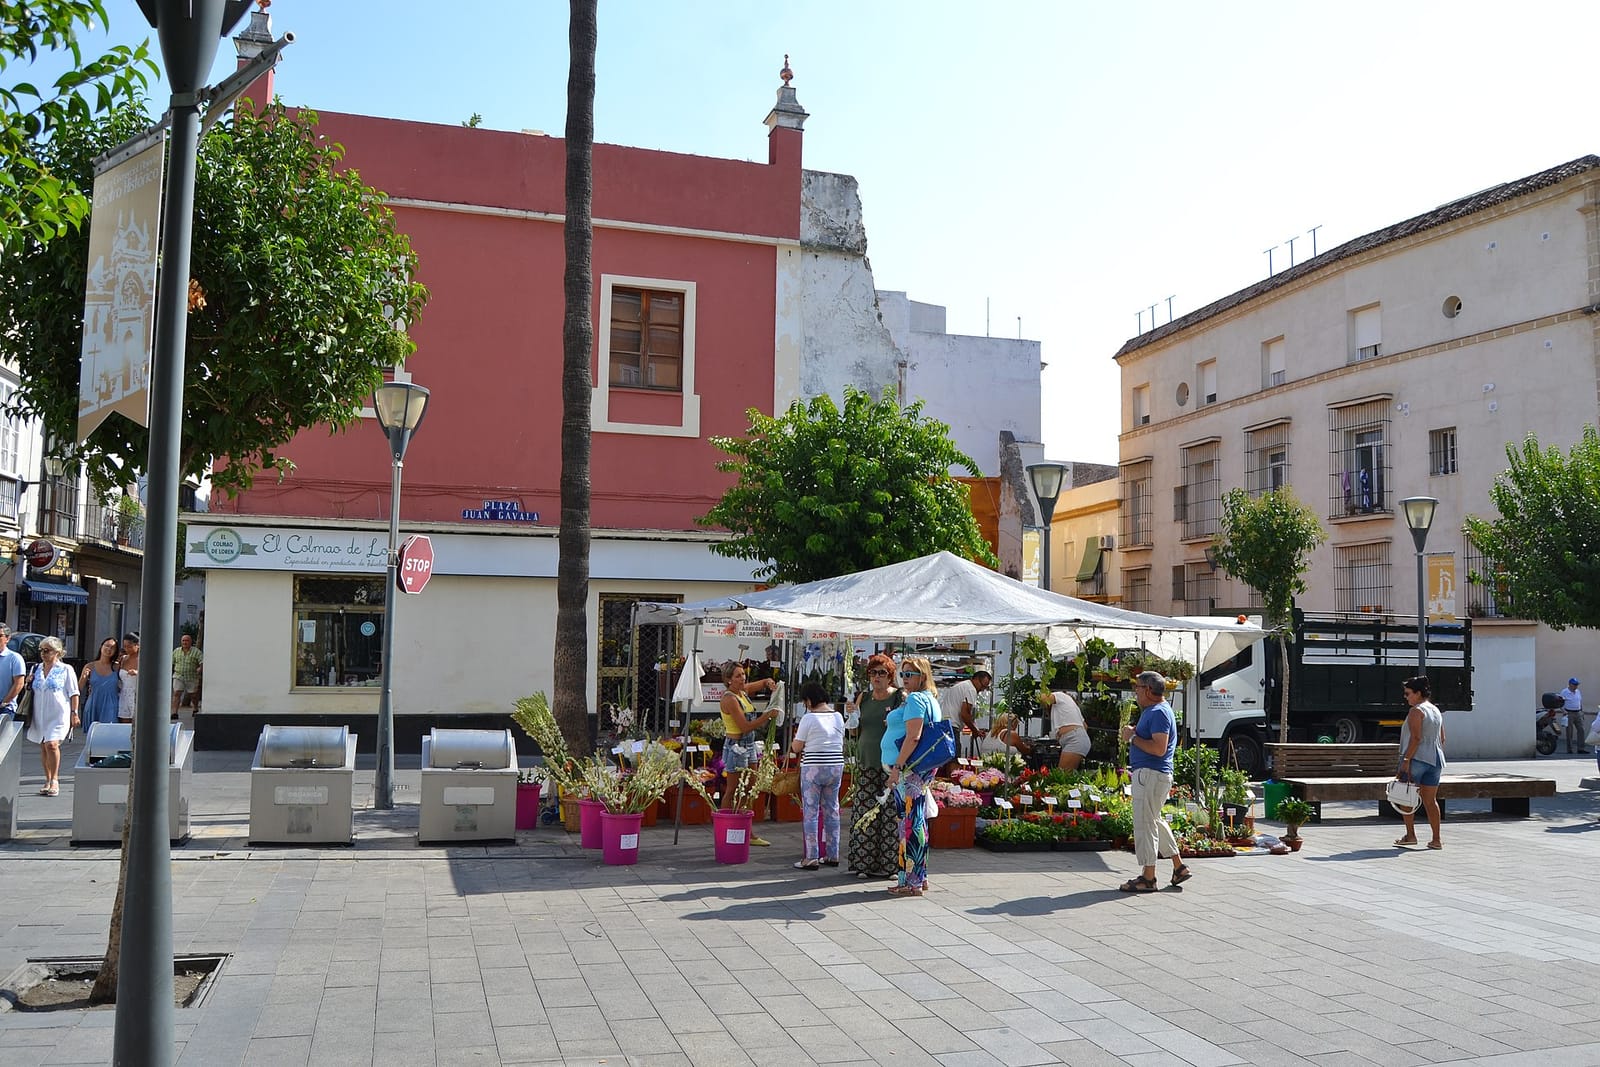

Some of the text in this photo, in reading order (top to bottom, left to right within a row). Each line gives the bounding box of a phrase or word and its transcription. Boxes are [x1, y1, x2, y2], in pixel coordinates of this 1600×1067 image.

[484, 501, 519, 511] PLAZA
[463, 510, 538, 520] JUAN GAVALA
[262, 533, 281, 553] El
[286, 534, 342, 554] Colmao
[346, 536, 362, 555] de
[405, 558, 430, 572] STOP
